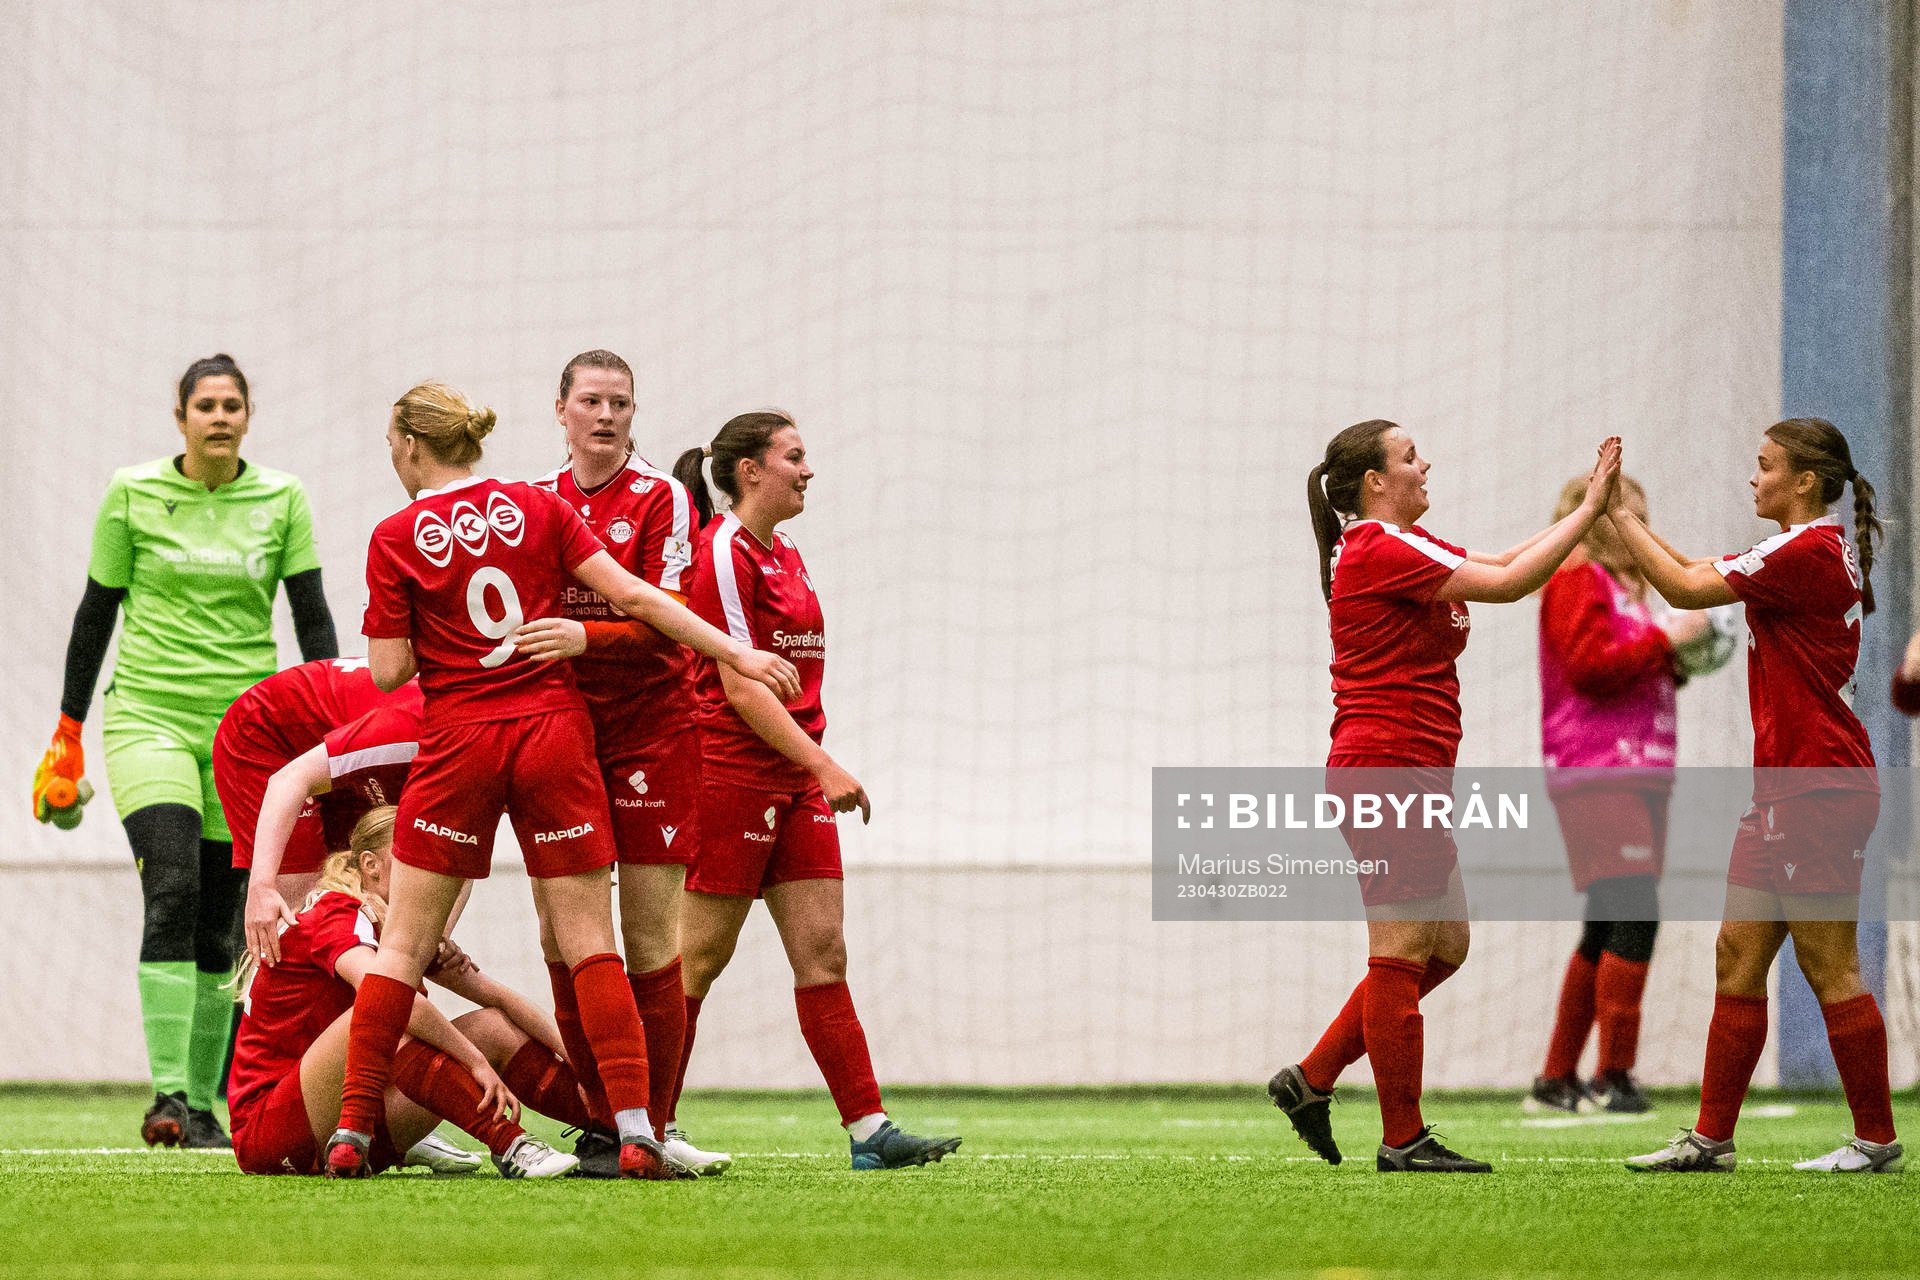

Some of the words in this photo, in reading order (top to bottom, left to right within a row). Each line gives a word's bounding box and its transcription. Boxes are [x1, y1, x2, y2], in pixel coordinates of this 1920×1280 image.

[466, 566, 524, 669] 9
[615, 798, 643, 808] POLAR
[645, 799, 666, 808] kraft
[414, 818, 478, 845] RAPIDA
[534, 822, 595, 844] RAPIDA
